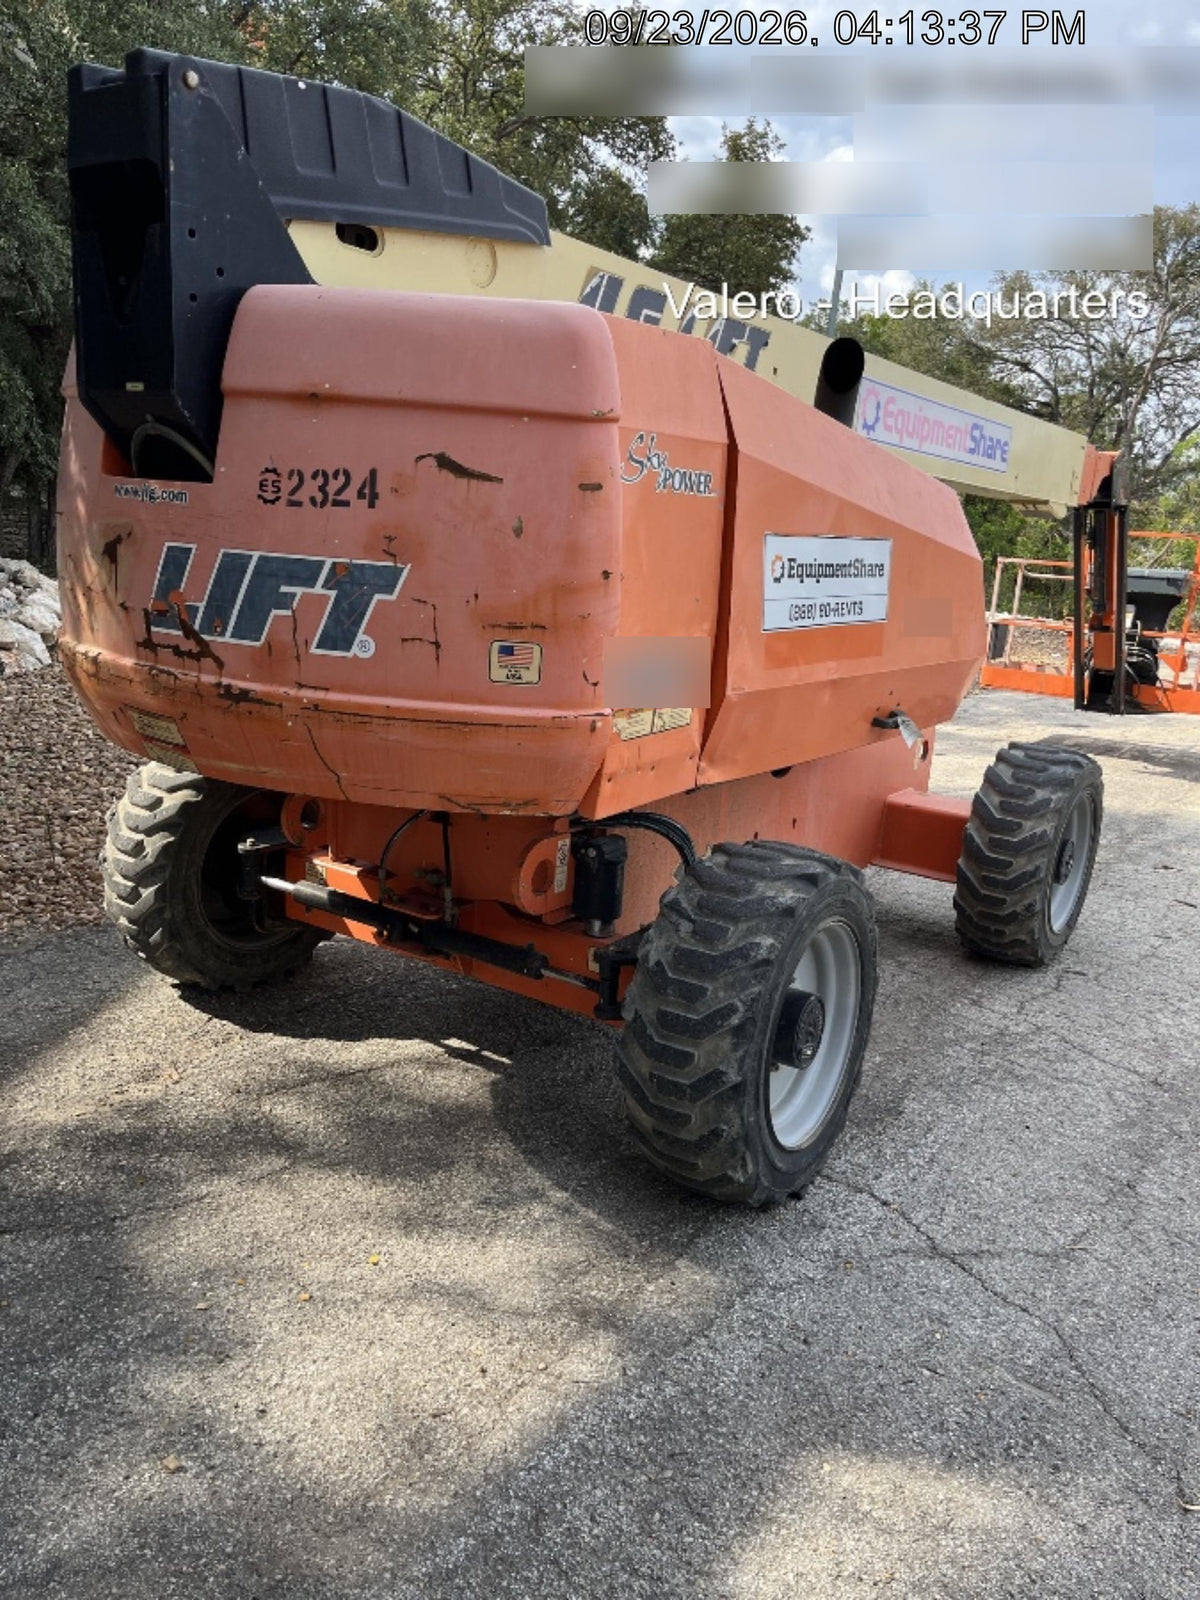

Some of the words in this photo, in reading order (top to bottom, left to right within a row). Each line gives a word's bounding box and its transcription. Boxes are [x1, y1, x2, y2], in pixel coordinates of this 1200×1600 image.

[882, 396, 1009, 463] EquipmentShare
[286, 468, 379, 509] 2324
[787, 558, 885, 583] EquipmentShare
